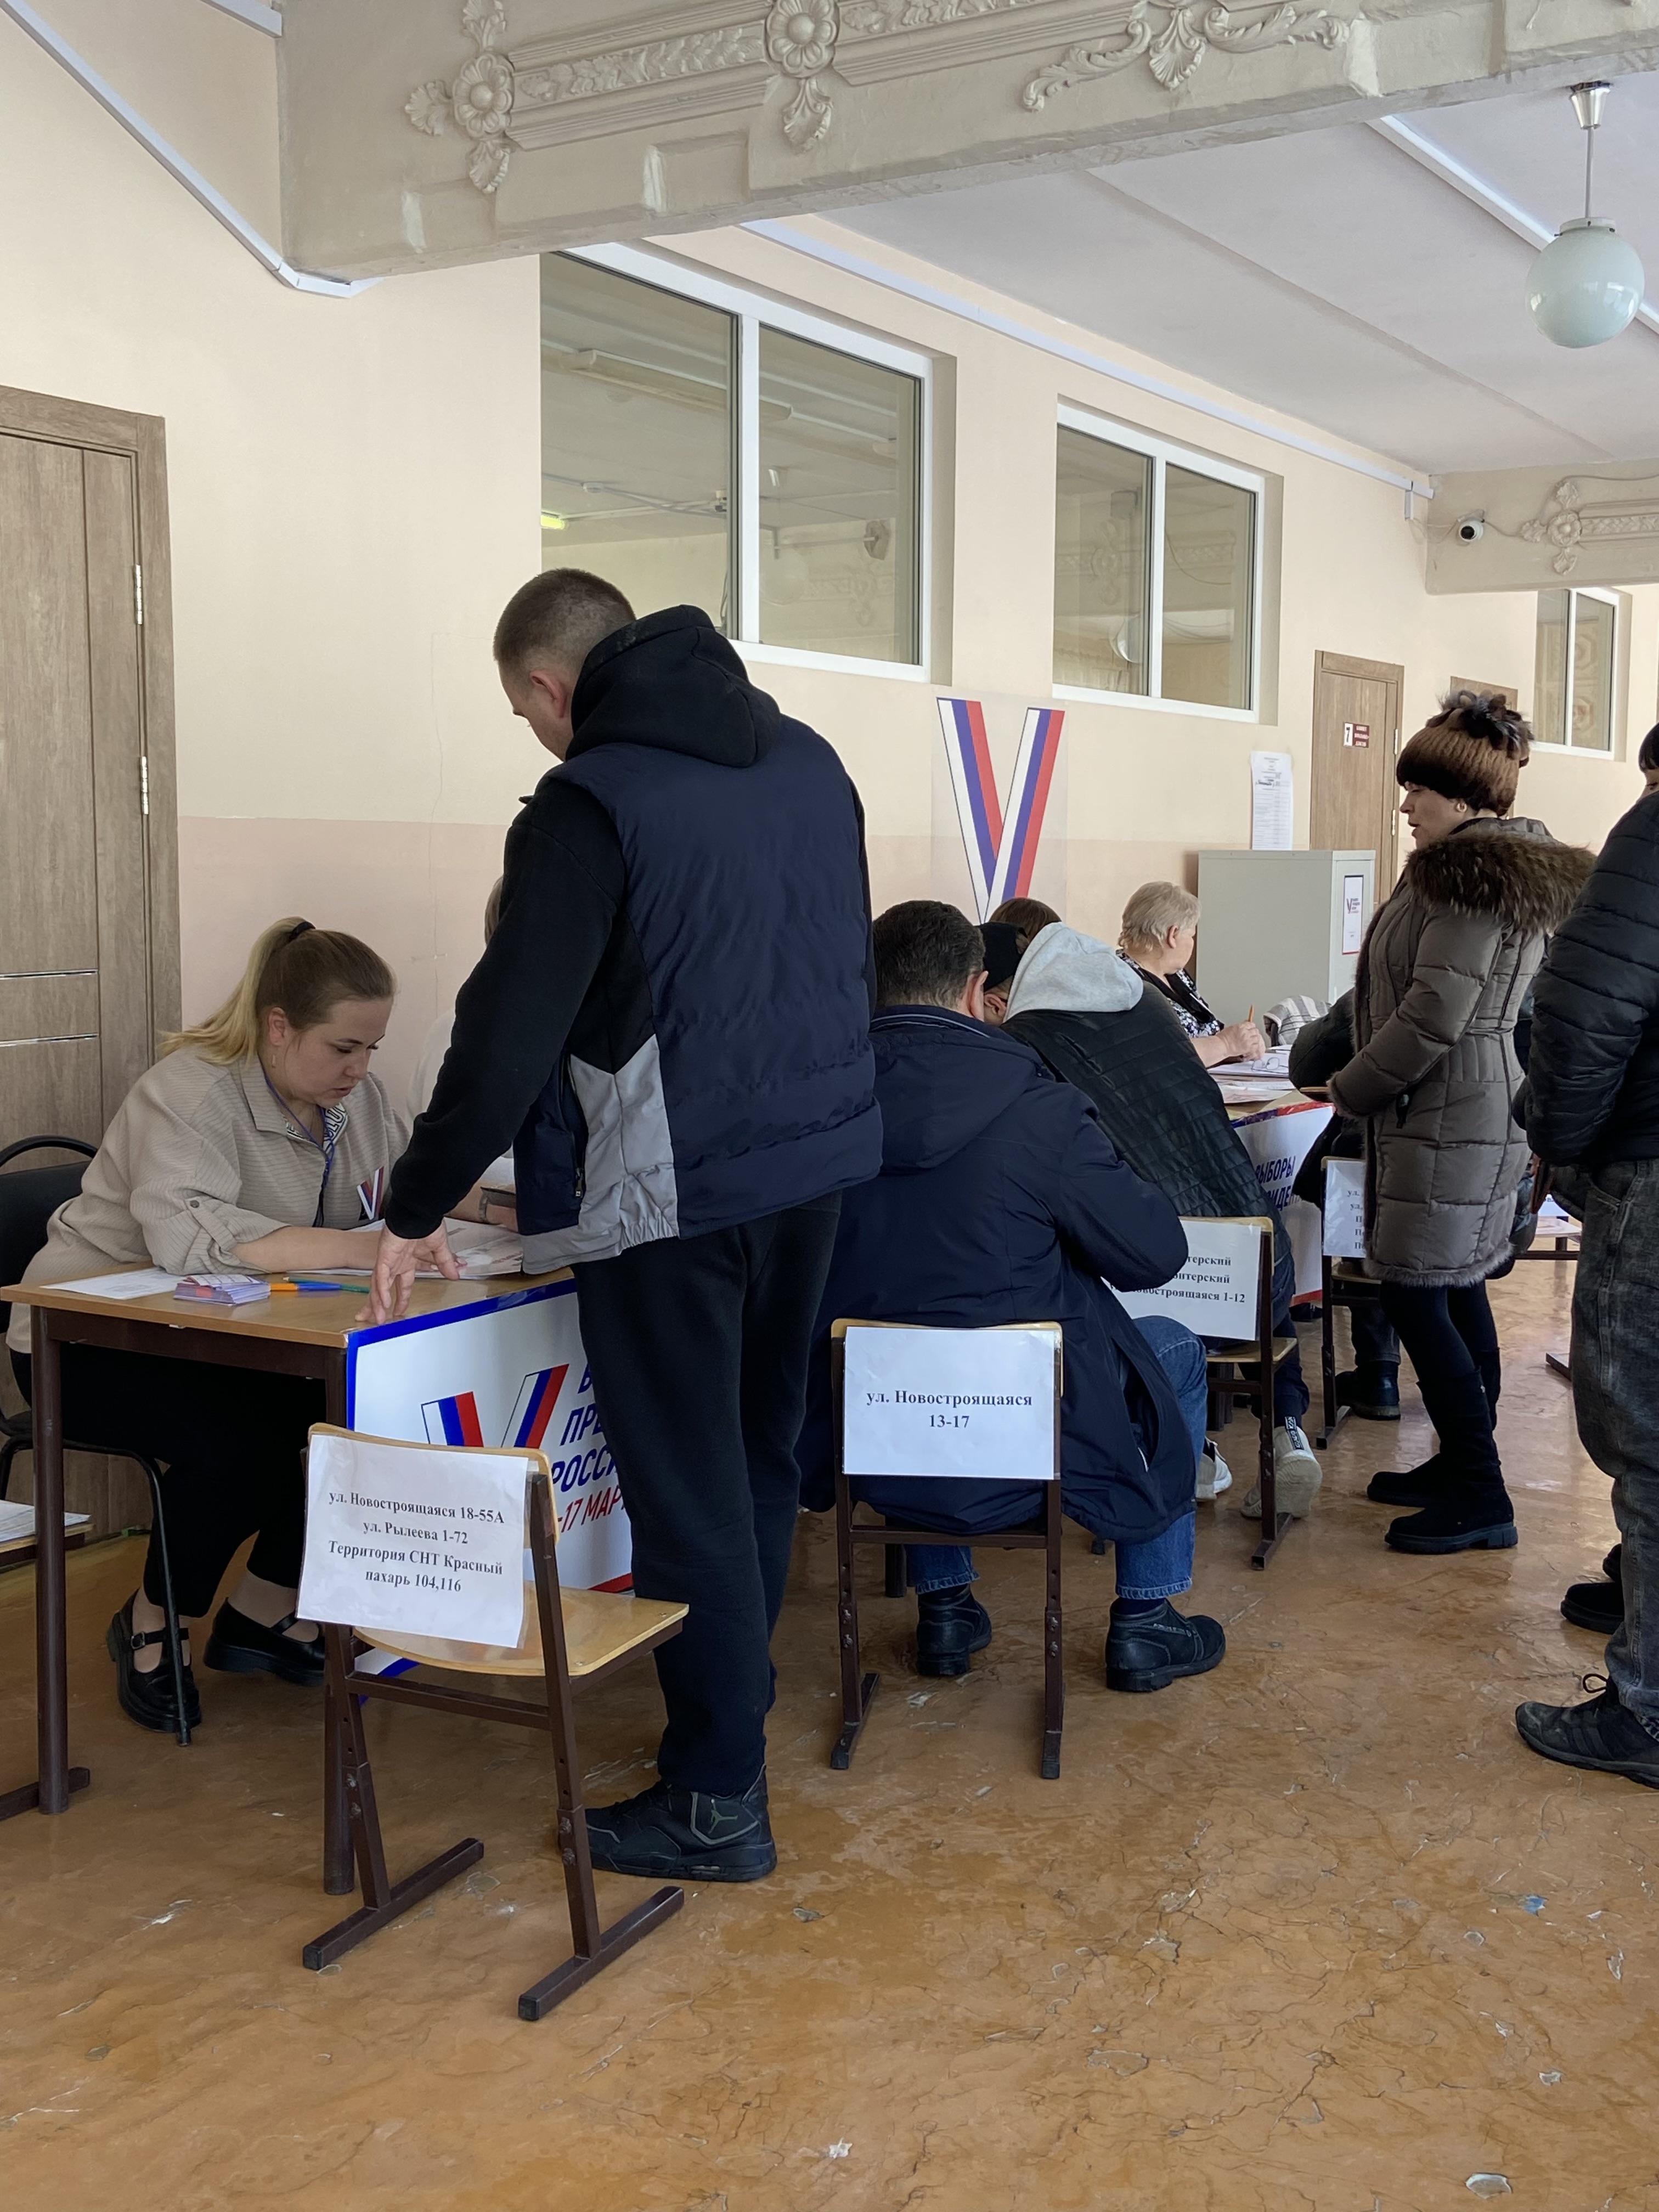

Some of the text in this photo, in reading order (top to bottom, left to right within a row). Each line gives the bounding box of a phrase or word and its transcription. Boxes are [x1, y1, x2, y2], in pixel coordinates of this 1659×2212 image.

[1187, 1255, 1231, 1266] терский
[1223, 1292, 1245, 1303] 1-12
[866, 1390, 1032, 1408] ул. Новостроящаяся
[928, 1414, 970, 1428] 13-17
[329, 1492, 505, 1524] ул. Новостроящаяся 18-55А
[580, 1485, 625, 1526] МАР
[363, 1521, 469, 1544] ул. Рылеева 1-72
[329, 1540, 503, 1575] Территория СНТ Красный
[365, 1570, 461, 1592] пахарь 104,116
